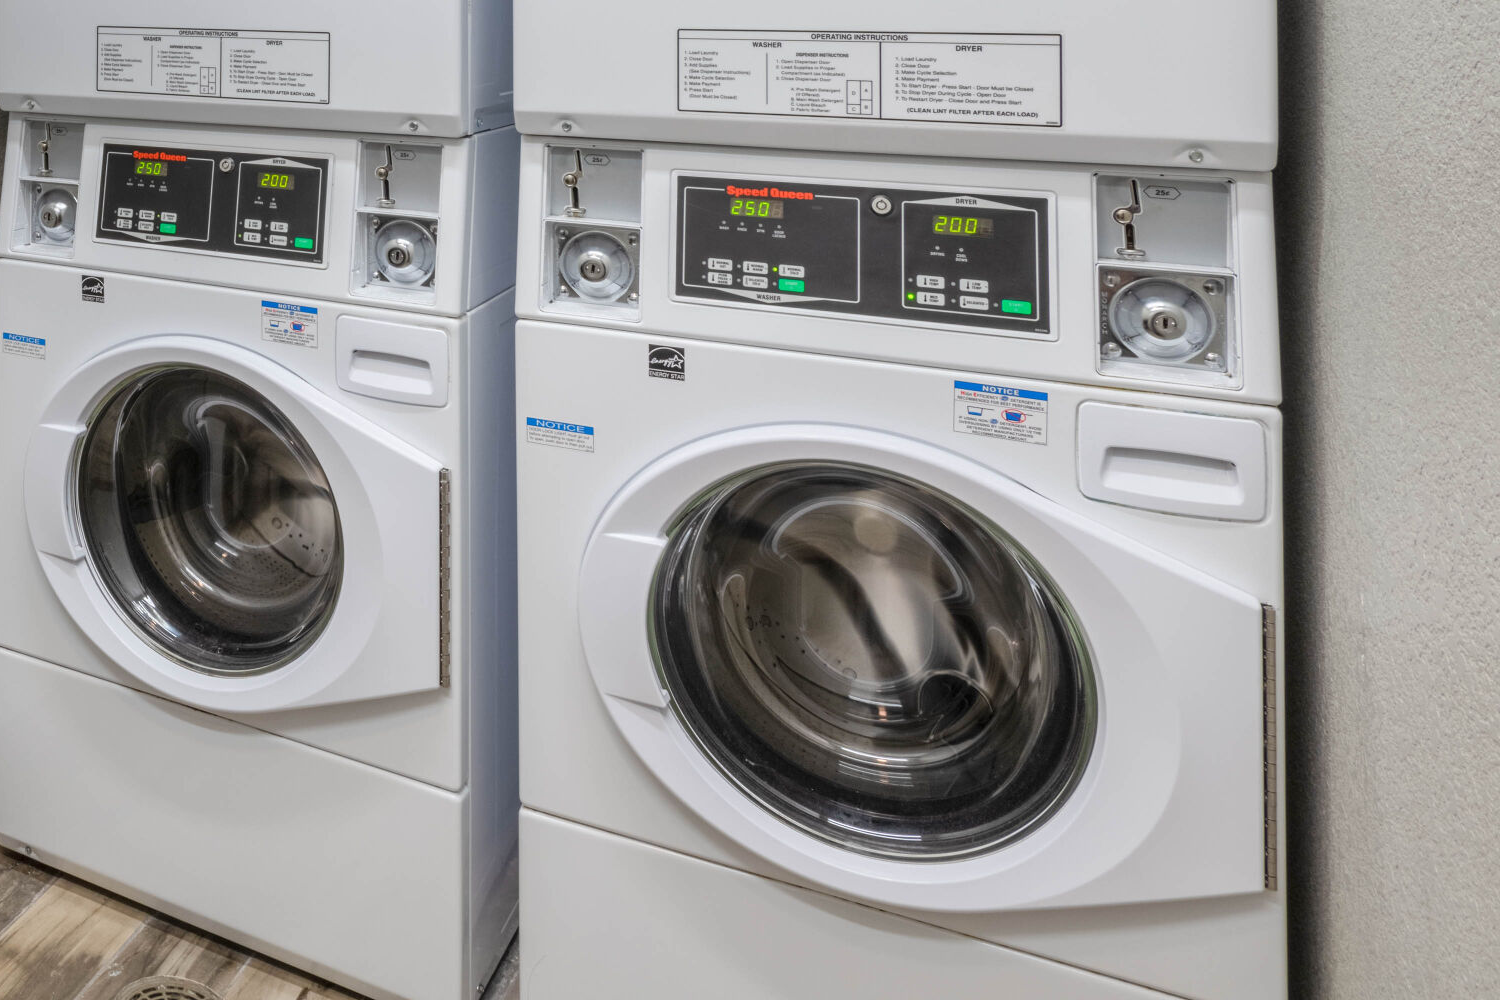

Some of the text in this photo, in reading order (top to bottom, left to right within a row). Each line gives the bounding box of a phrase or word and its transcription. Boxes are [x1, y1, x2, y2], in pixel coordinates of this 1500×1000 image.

[133, 151, 186, 162] Speed Queen
[137, 162, 161, 174] 250
[261, 174, 289, 188] 200
[727, 185, 814, 200] Speed Queen
[731, 200, 770, 217] 250
[934, 216, 978, 234] 200
[8, 334, 41, 344] NOTICE
[982, 385, 1020, 395] NOTICE
[536, 420, 585, 433] NOTICE
